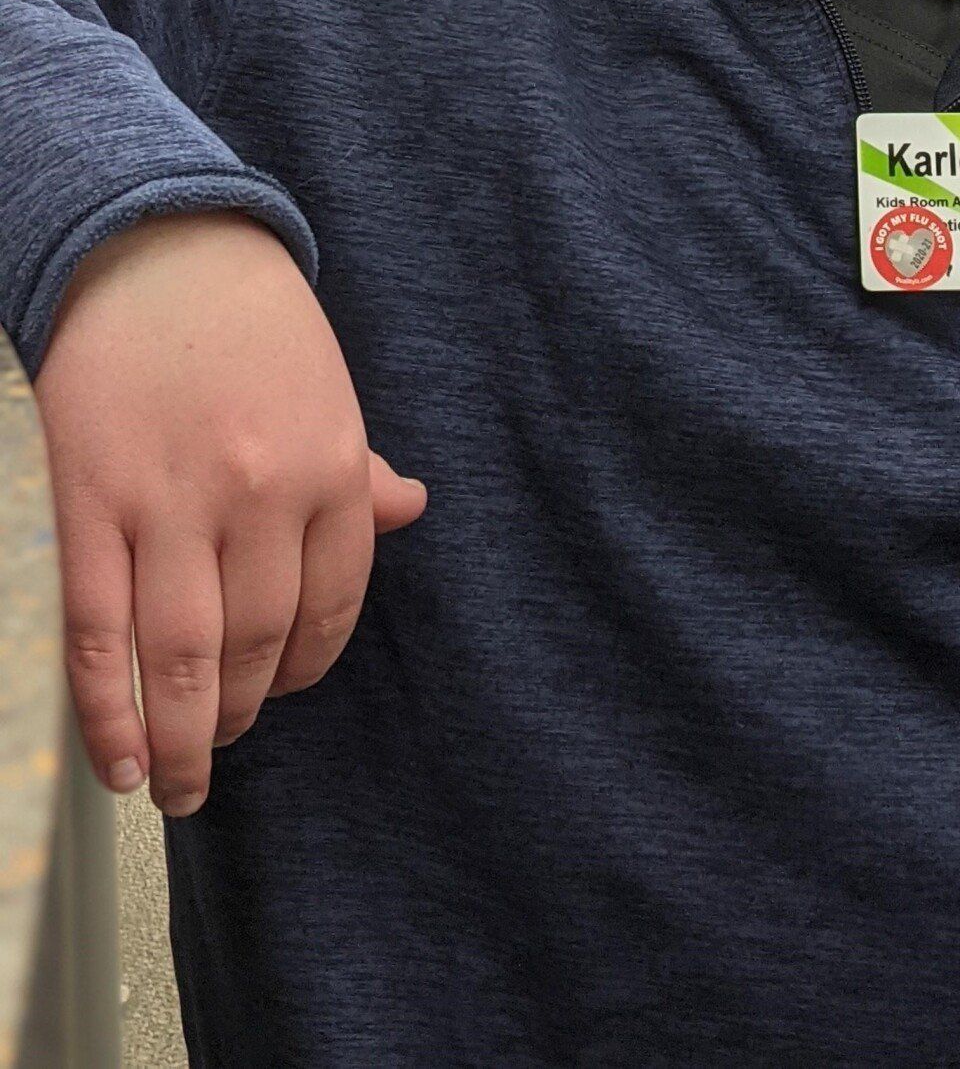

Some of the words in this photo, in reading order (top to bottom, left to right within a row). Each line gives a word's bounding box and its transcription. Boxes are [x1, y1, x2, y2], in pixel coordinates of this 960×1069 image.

[876, 197, 906, 208] Kids
[909, 196, 948, 208] Room
[876, 222, 891, 245] GOT
[890, 213, 907, 226] MY
[909, 213, 930, 226] FLU
[928, 222, 947, 250] SHOT
[910, 238, 932, 269] 2020-21
